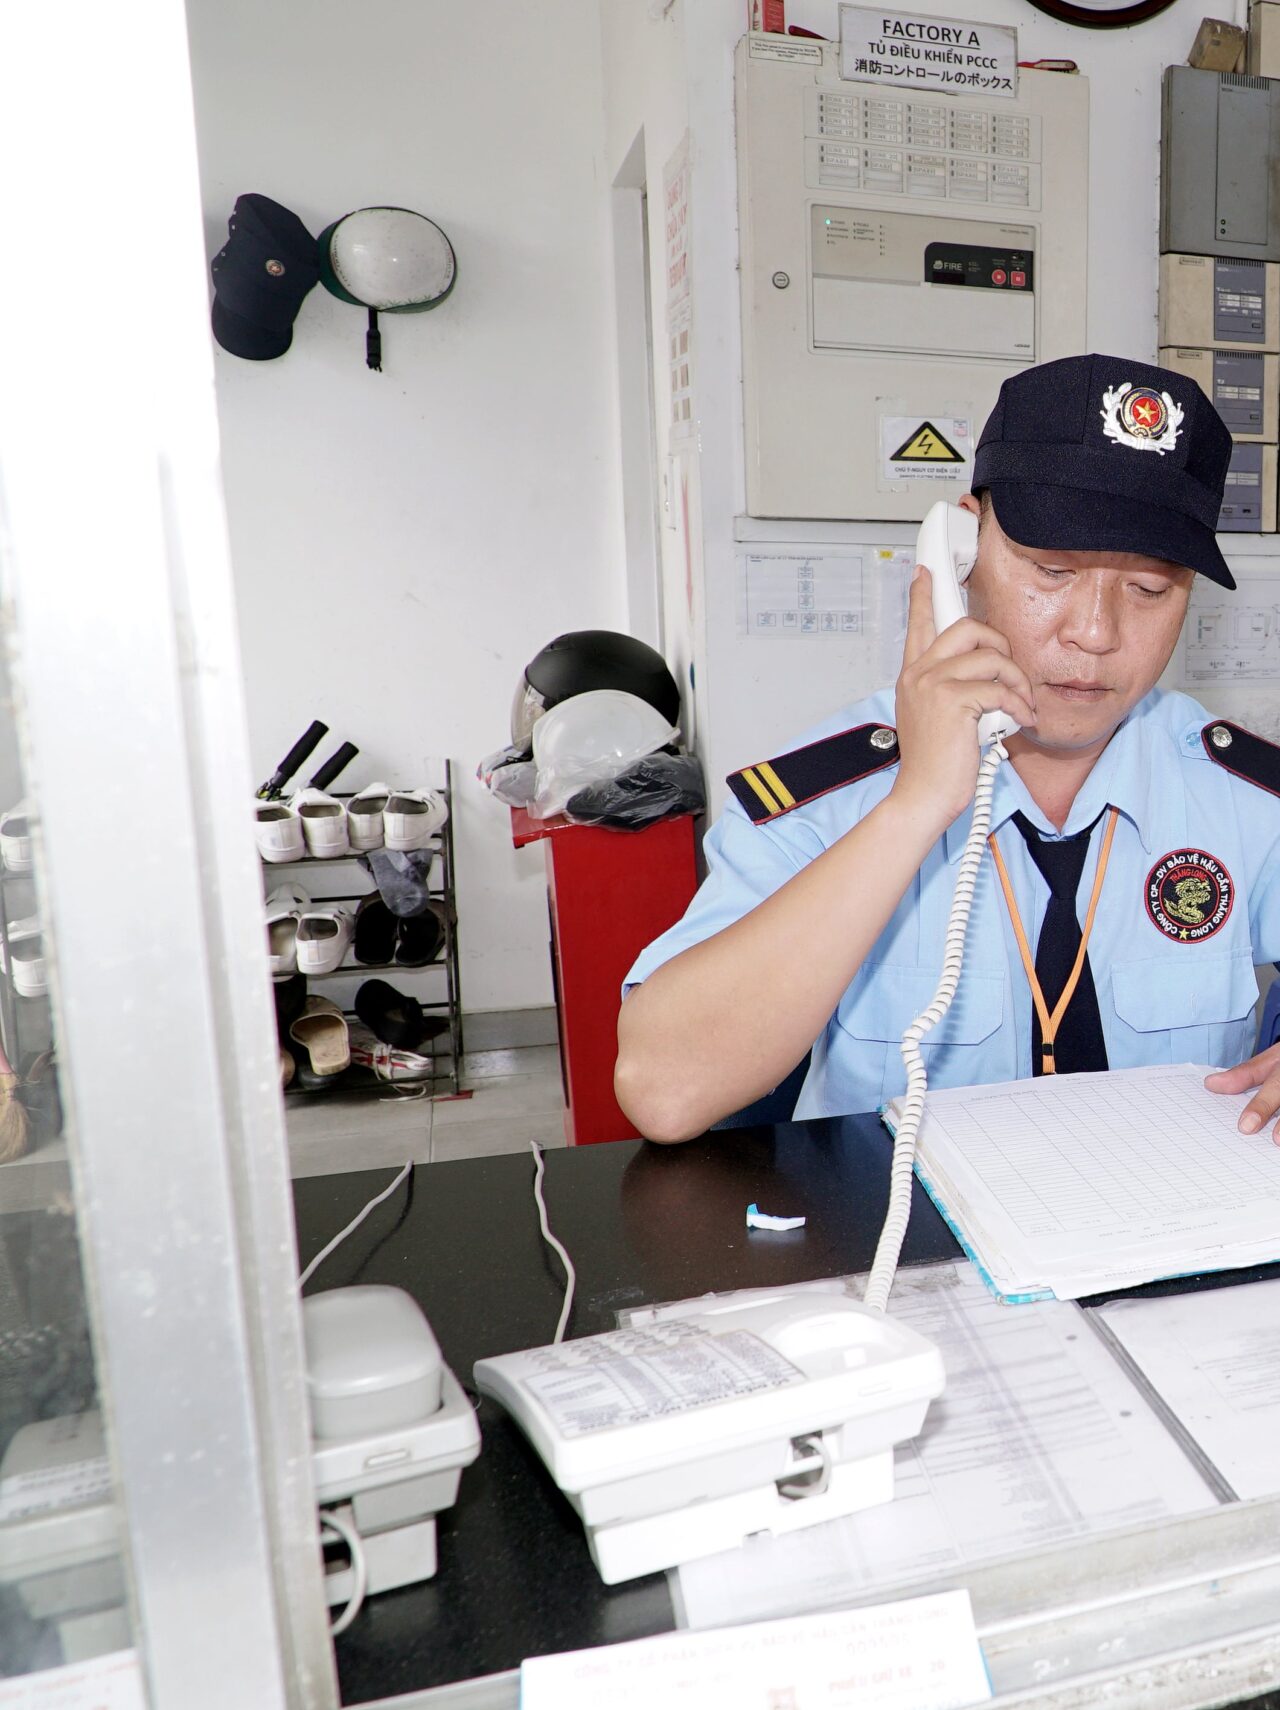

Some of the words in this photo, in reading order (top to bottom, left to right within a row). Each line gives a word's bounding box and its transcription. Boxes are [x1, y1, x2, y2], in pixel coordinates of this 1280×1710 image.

[882, 19, 963, 43] FACTORY
[967, 31, 981, 46] A
[868, 38, 886, 55] TỦ
[890, 42, 921, 59] ĐIỀU
[966, 55, 998, 69] PCCC
[855, 58, 1013, 90] 消防コントロールのボックス
[944, 262, 963, 270] FIRE
[1166, 854, 1186, 869] BẢO
[1186, 853, 1200, 865] VỆ
[1199, 857, 1219, 873] HẬU
[1151, 900, 1161, 914] TY
[1156, 912, 1178, 935] CÔNG
[1190, 923, 1215, 938] LONG
